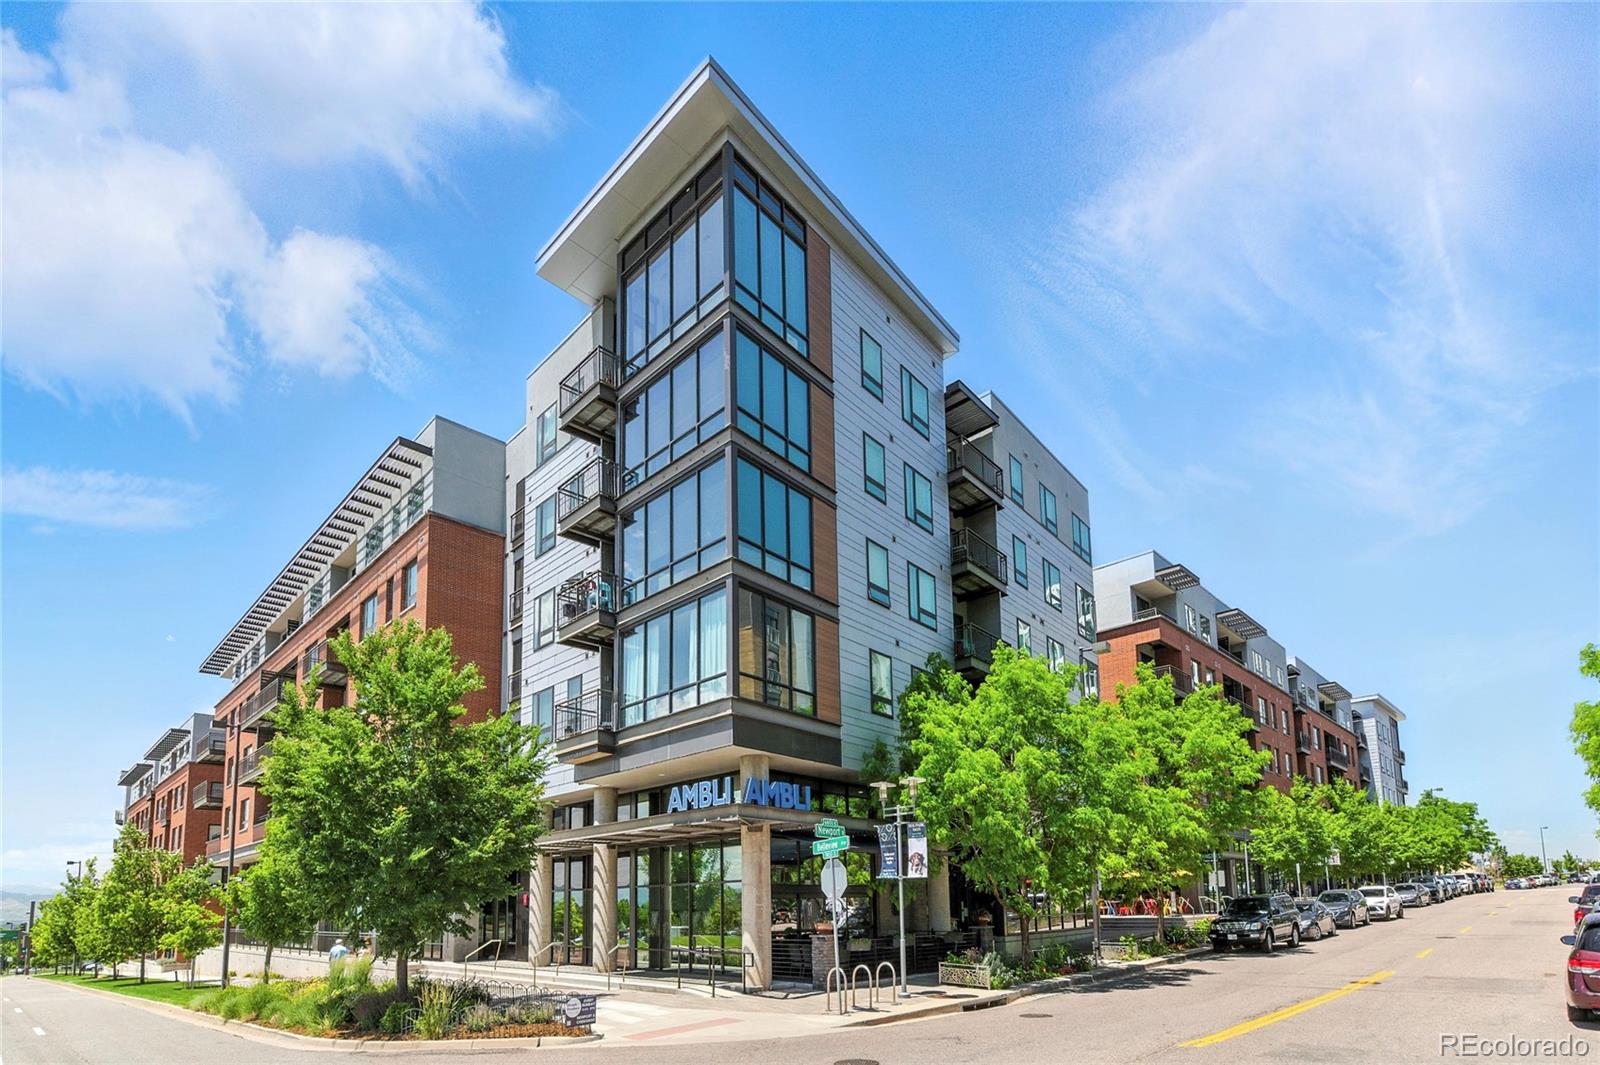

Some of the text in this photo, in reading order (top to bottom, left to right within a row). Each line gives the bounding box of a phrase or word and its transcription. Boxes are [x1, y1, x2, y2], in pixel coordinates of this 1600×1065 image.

[667, 776, 732, 814] AMBLI
[744, 777, 811, 811] AMBLI
[818, 826, 840, 836] Newport
